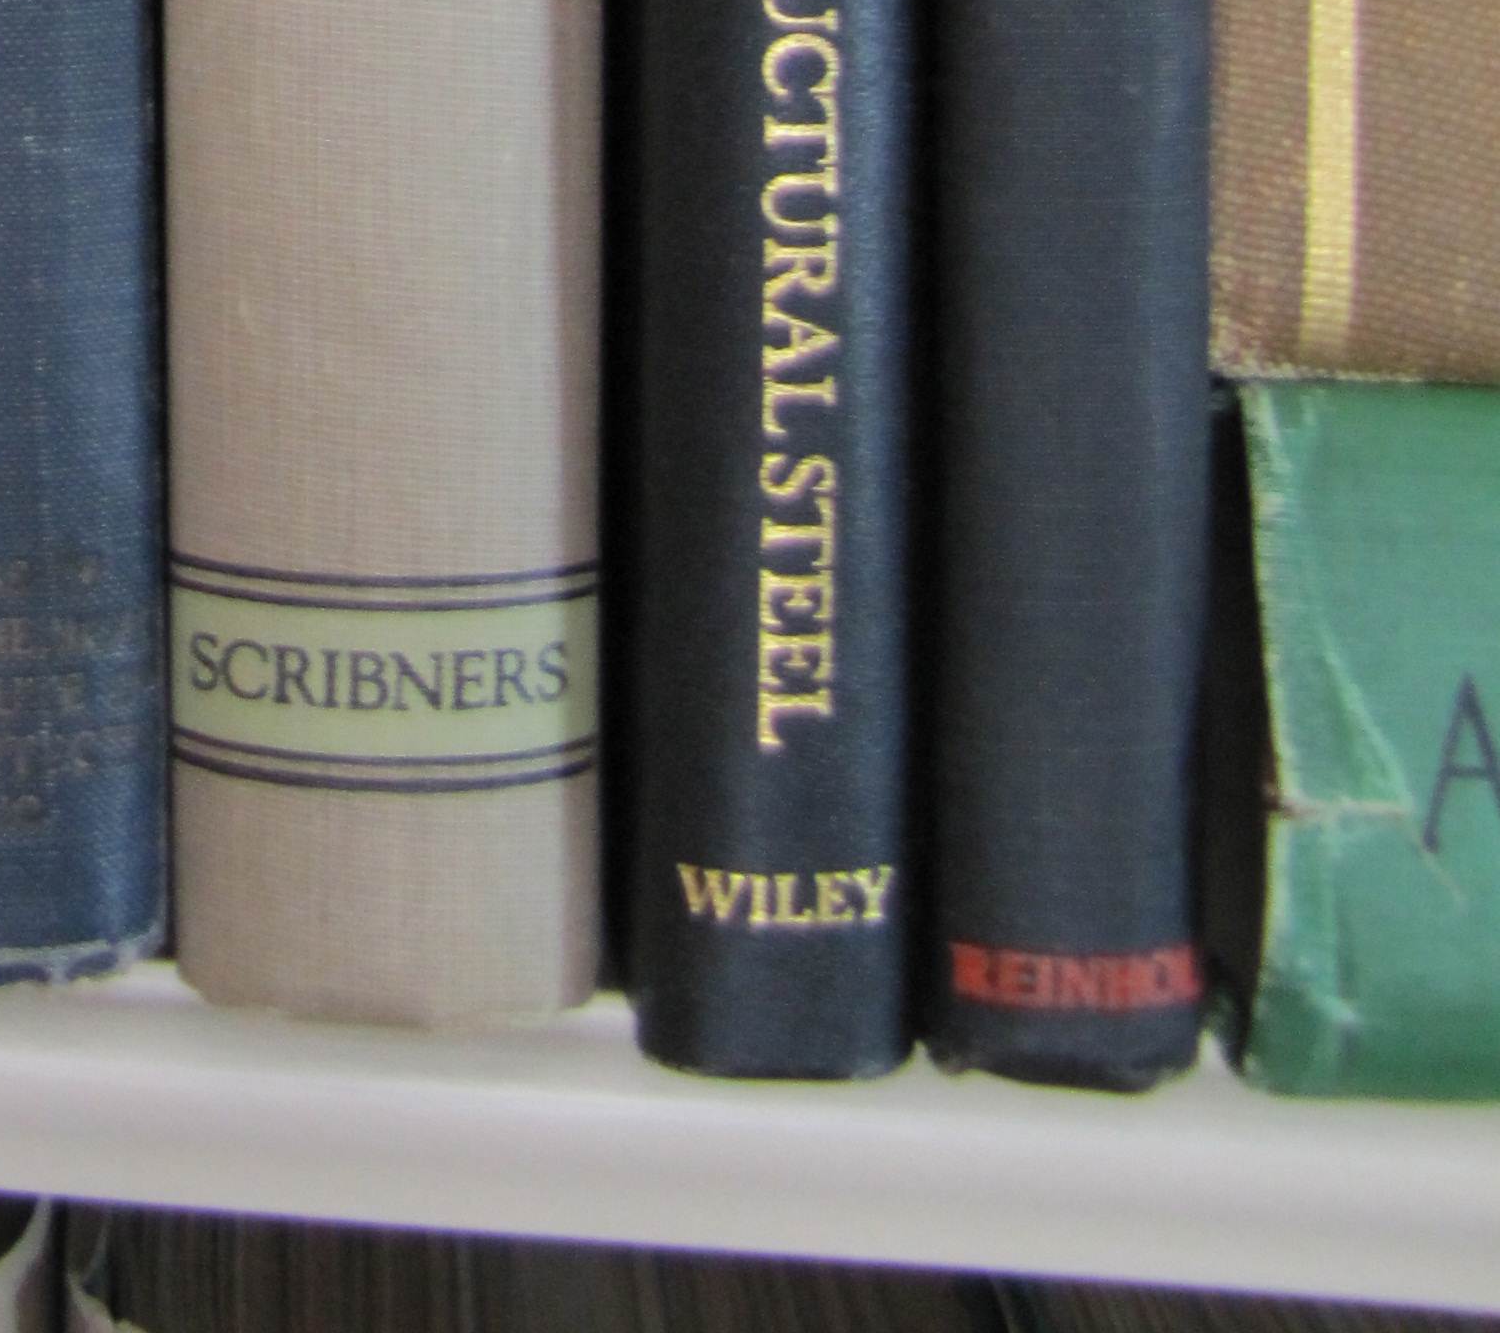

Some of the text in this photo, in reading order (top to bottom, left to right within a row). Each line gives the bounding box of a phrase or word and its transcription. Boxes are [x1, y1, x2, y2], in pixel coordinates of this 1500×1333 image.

[757, 453, 838, 755] STEEL
[189, 632, 568, 711] SCRIBNERS
[676, 861, 894, 925] WILEY
